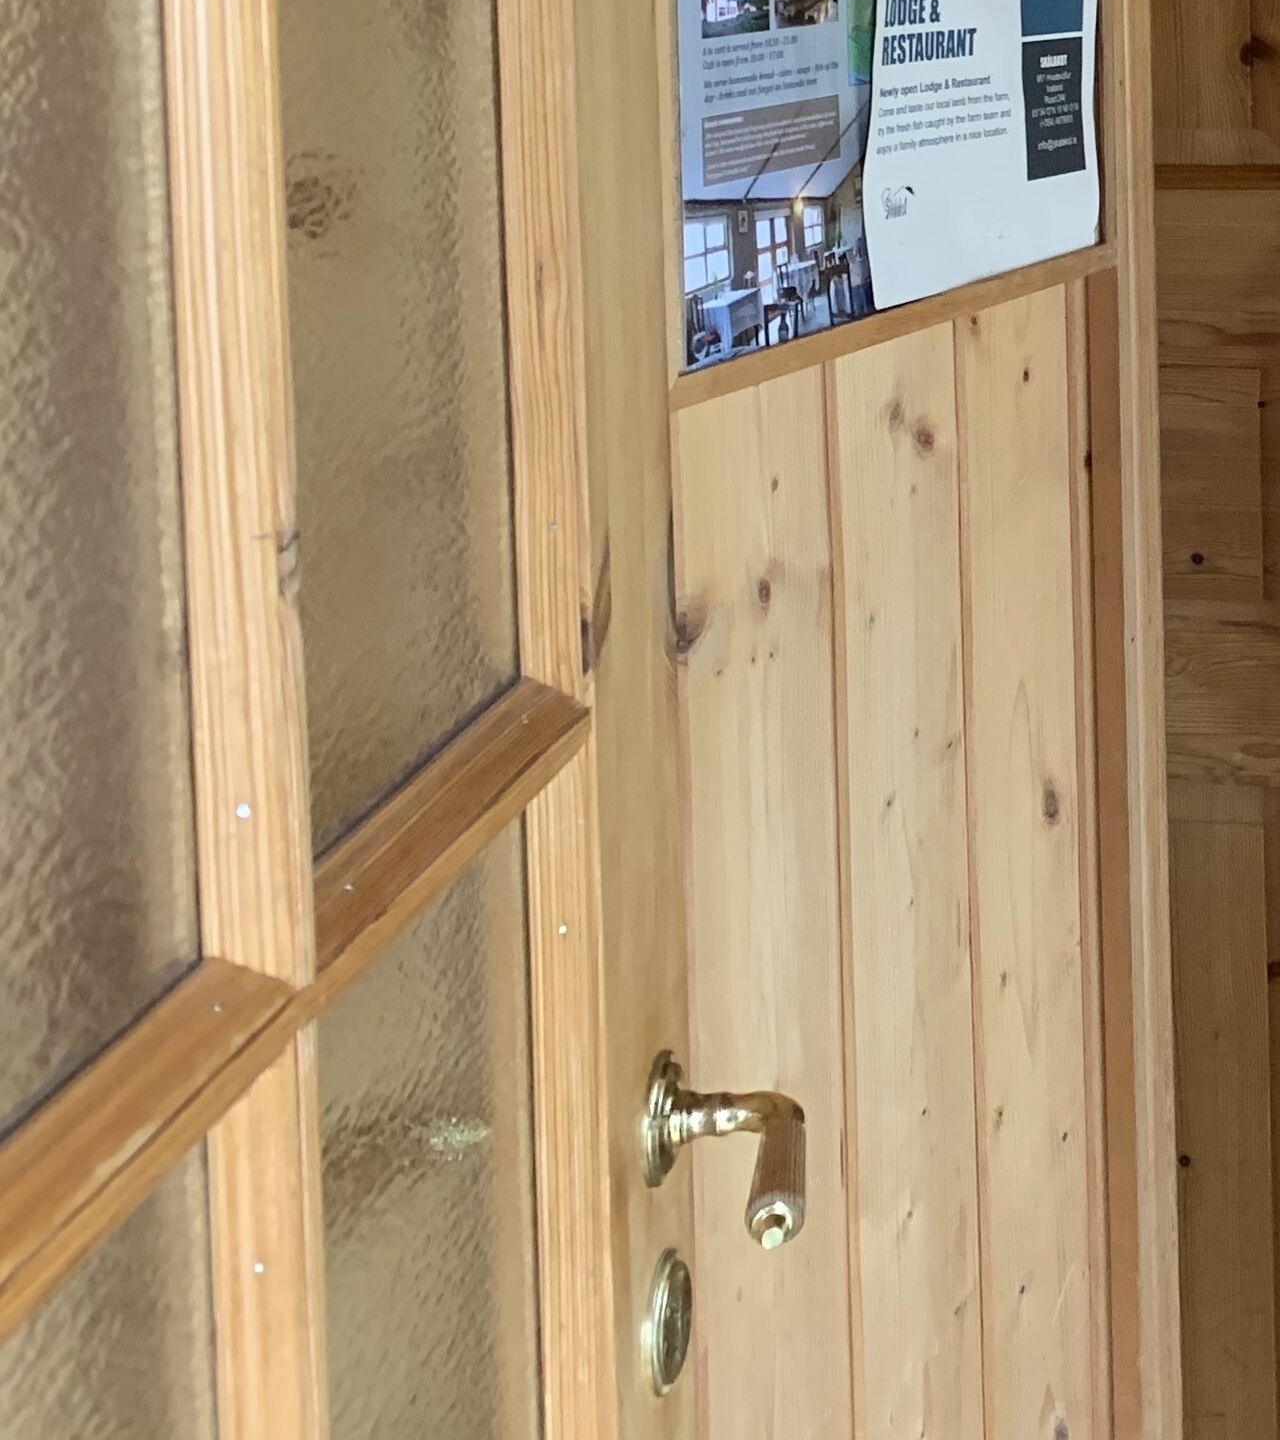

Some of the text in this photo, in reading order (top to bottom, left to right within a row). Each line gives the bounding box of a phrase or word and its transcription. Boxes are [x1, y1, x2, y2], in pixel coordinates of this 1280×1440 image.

[881, 28, 977, 66] RESTAURANT
[880, 75, 991, 99] Newly open Lodge & Restaurant
